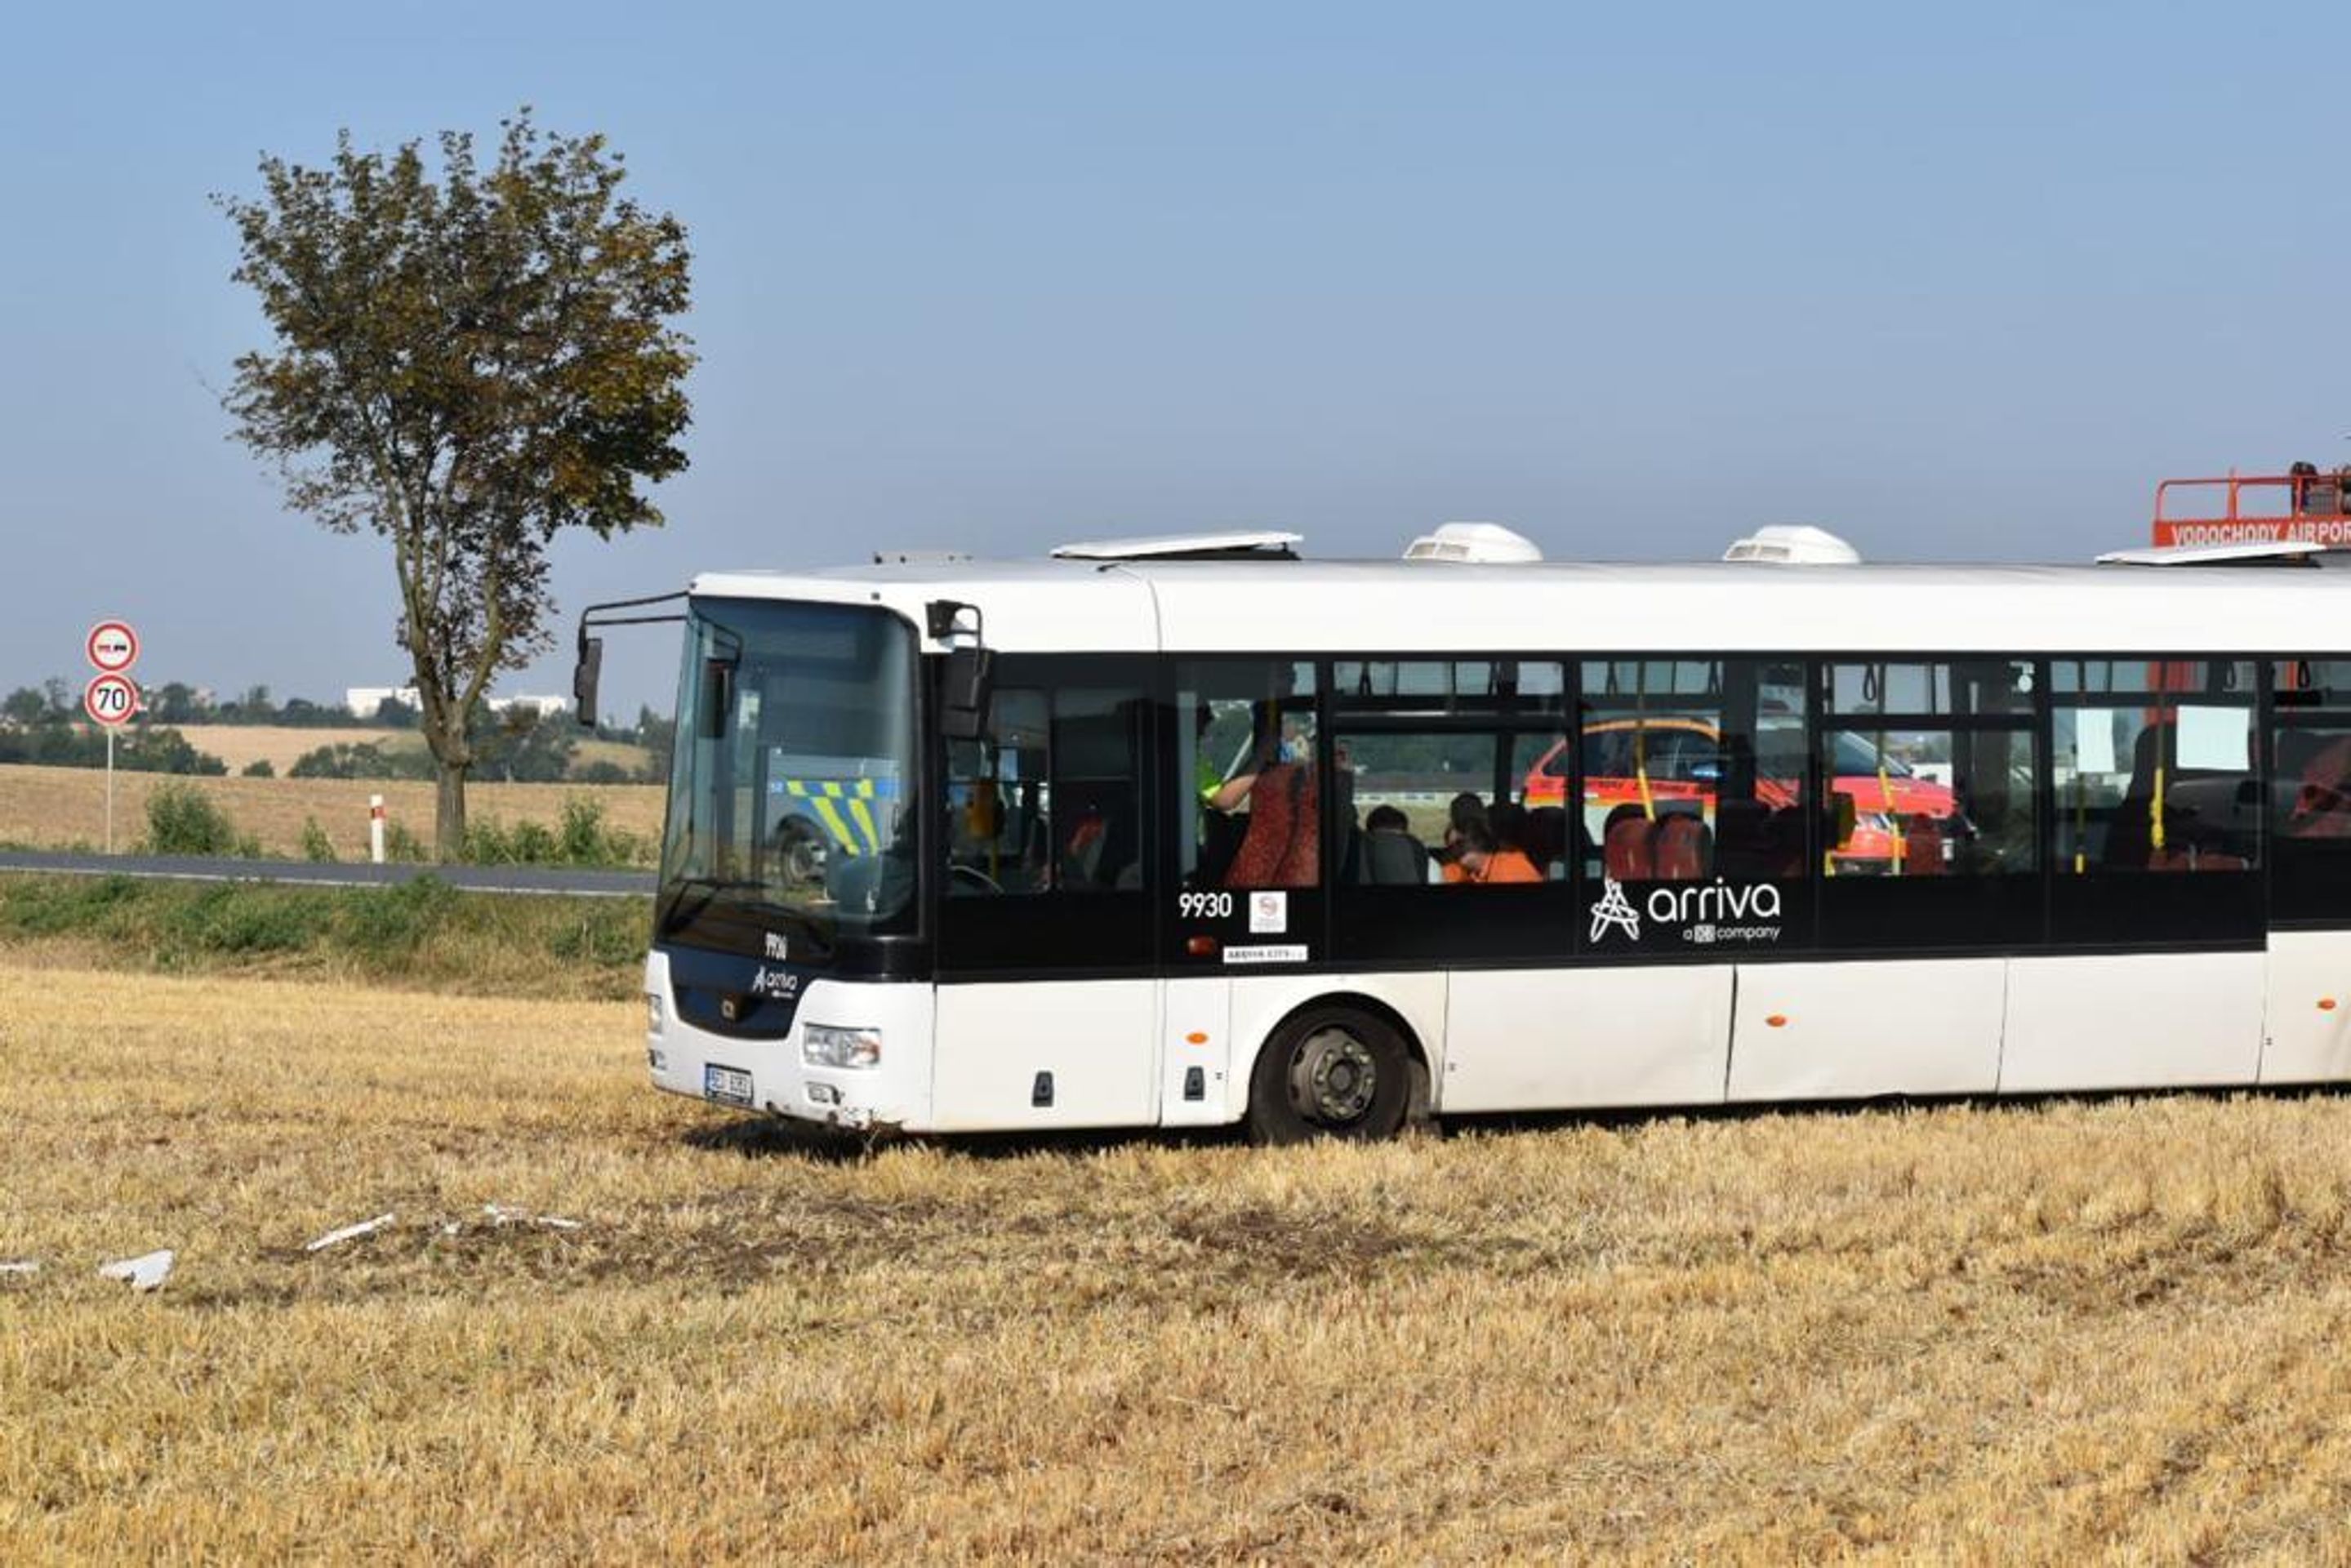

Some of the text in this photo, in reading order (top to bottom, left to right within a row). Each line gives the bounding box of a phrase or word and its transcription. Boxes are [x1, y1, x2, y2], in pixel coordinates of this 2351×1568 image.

[2172, 523, 2280, 546] VODOCHODY
[98, 688, 126, 710] 70
[1179, 893, 1232, 917] 9930
[1648, 876, 1780, 922] arriva
[1716, 926, 1781, 943] company
